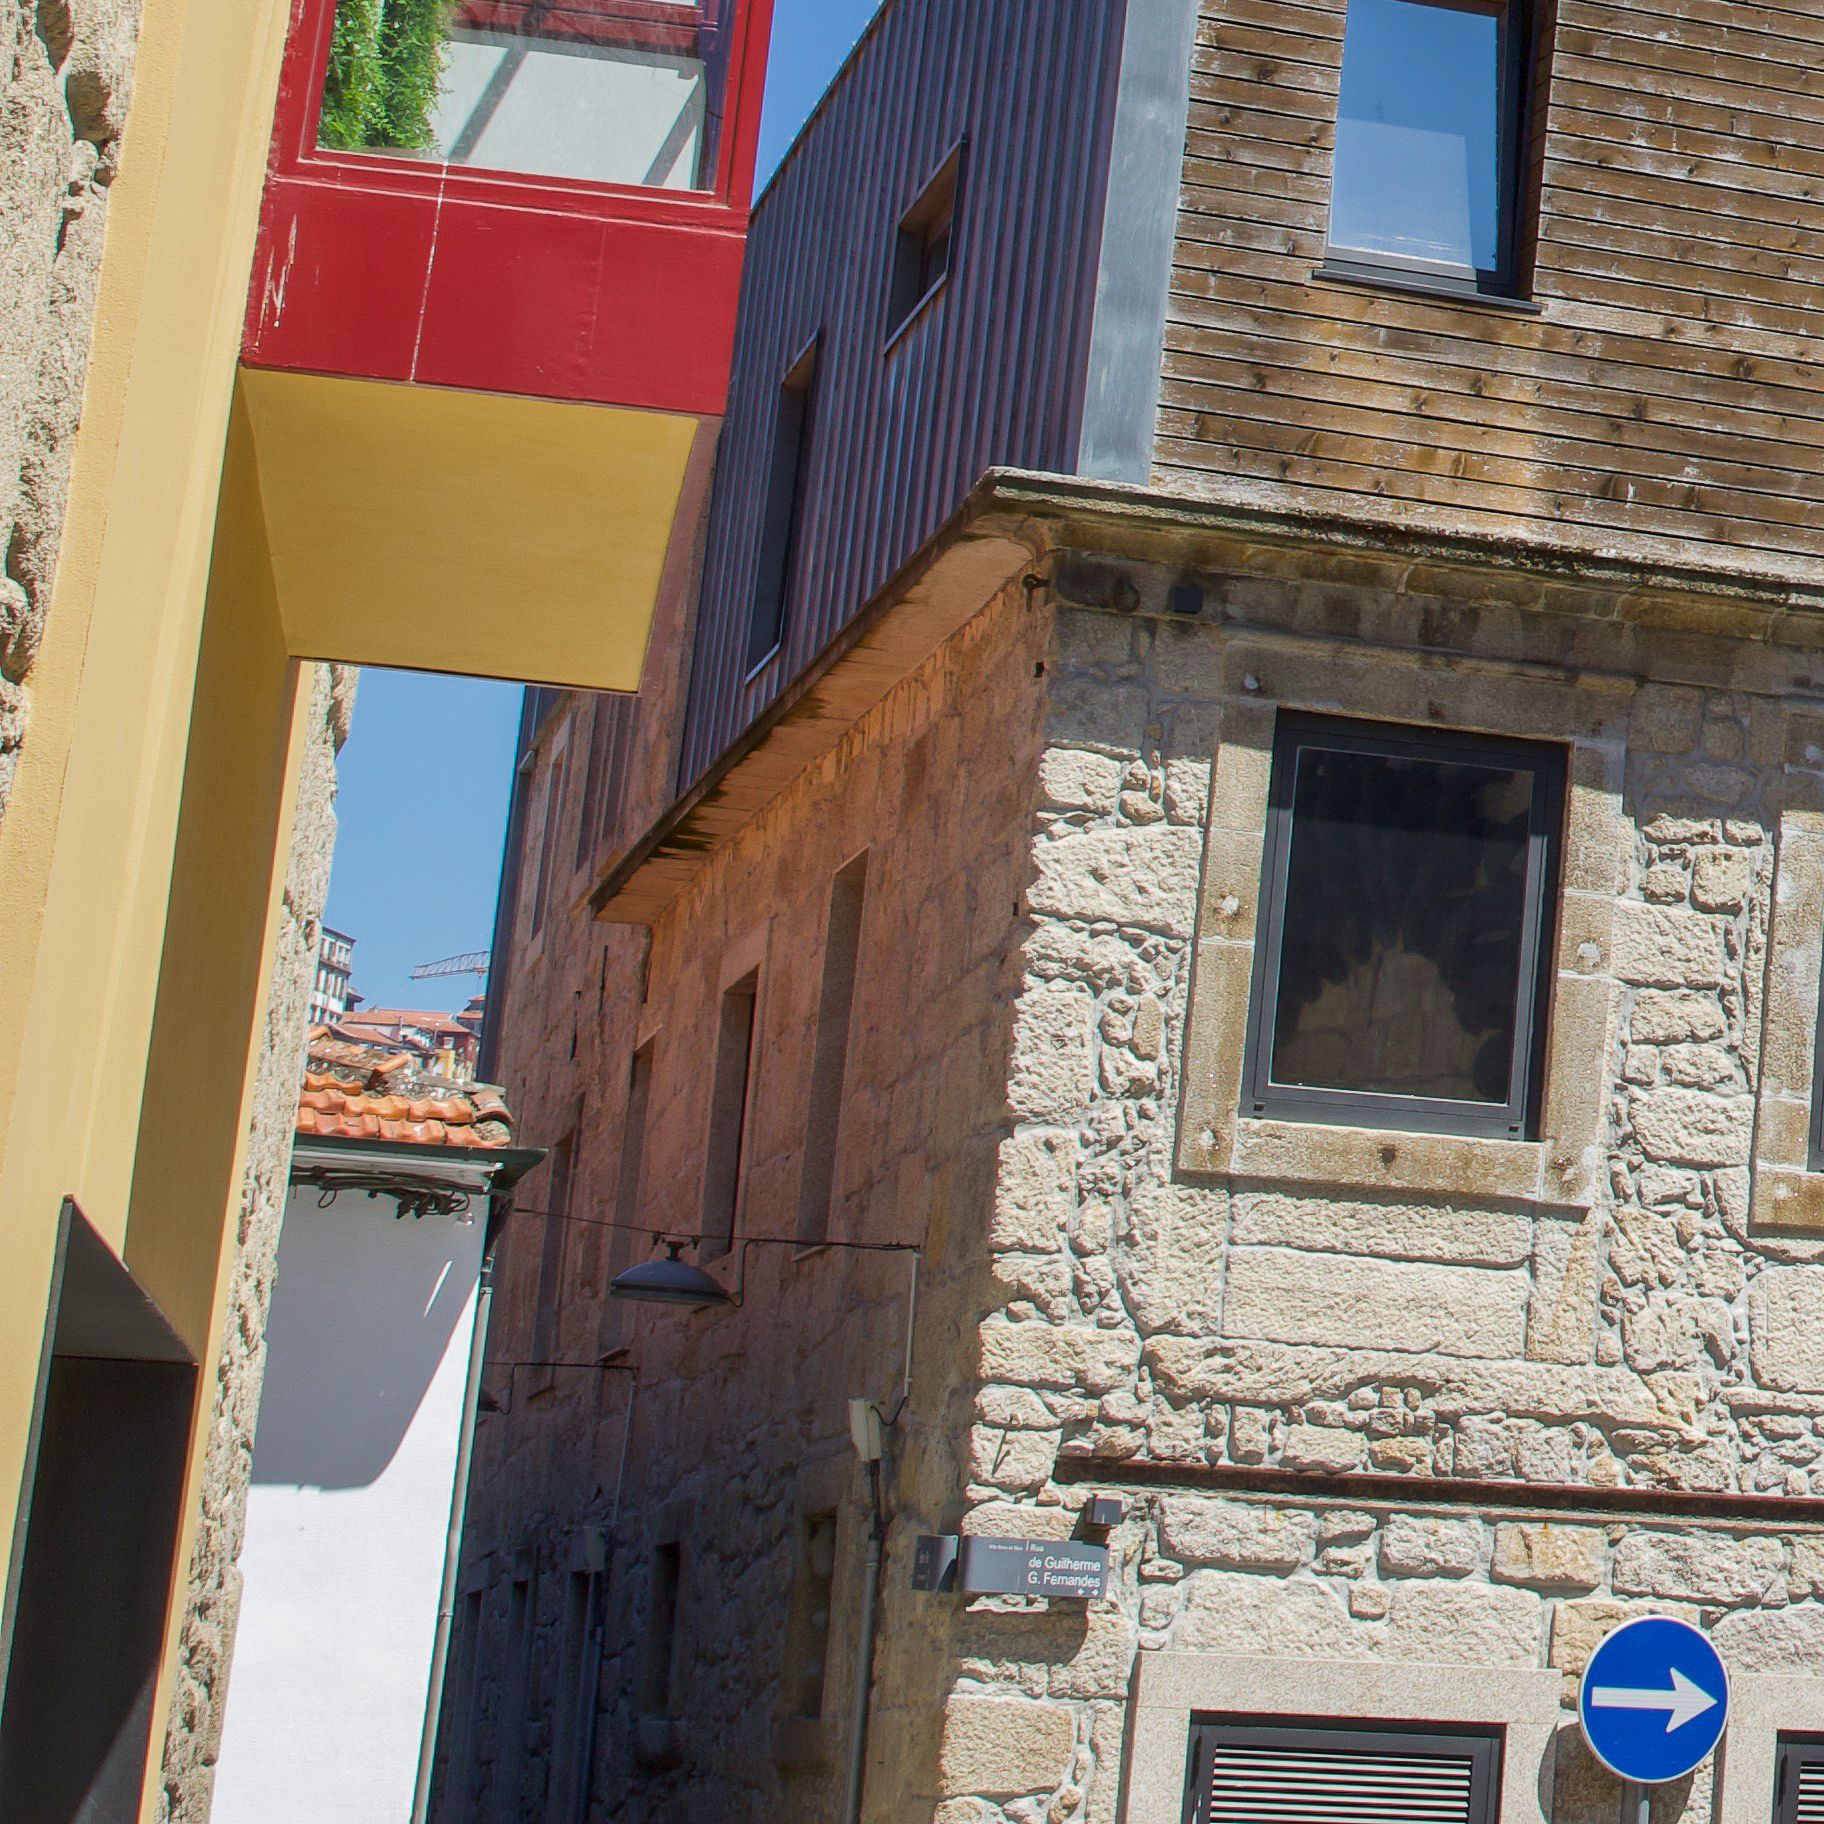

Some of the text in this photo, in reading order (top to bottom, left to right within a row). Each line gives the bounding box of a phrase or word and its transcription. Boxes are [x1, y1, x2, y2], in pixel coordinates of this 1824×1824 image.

[1029, 1556, 1101, 1571] de Guilherme
[1027, 1570, 1101, 1588] G. Fernandes
